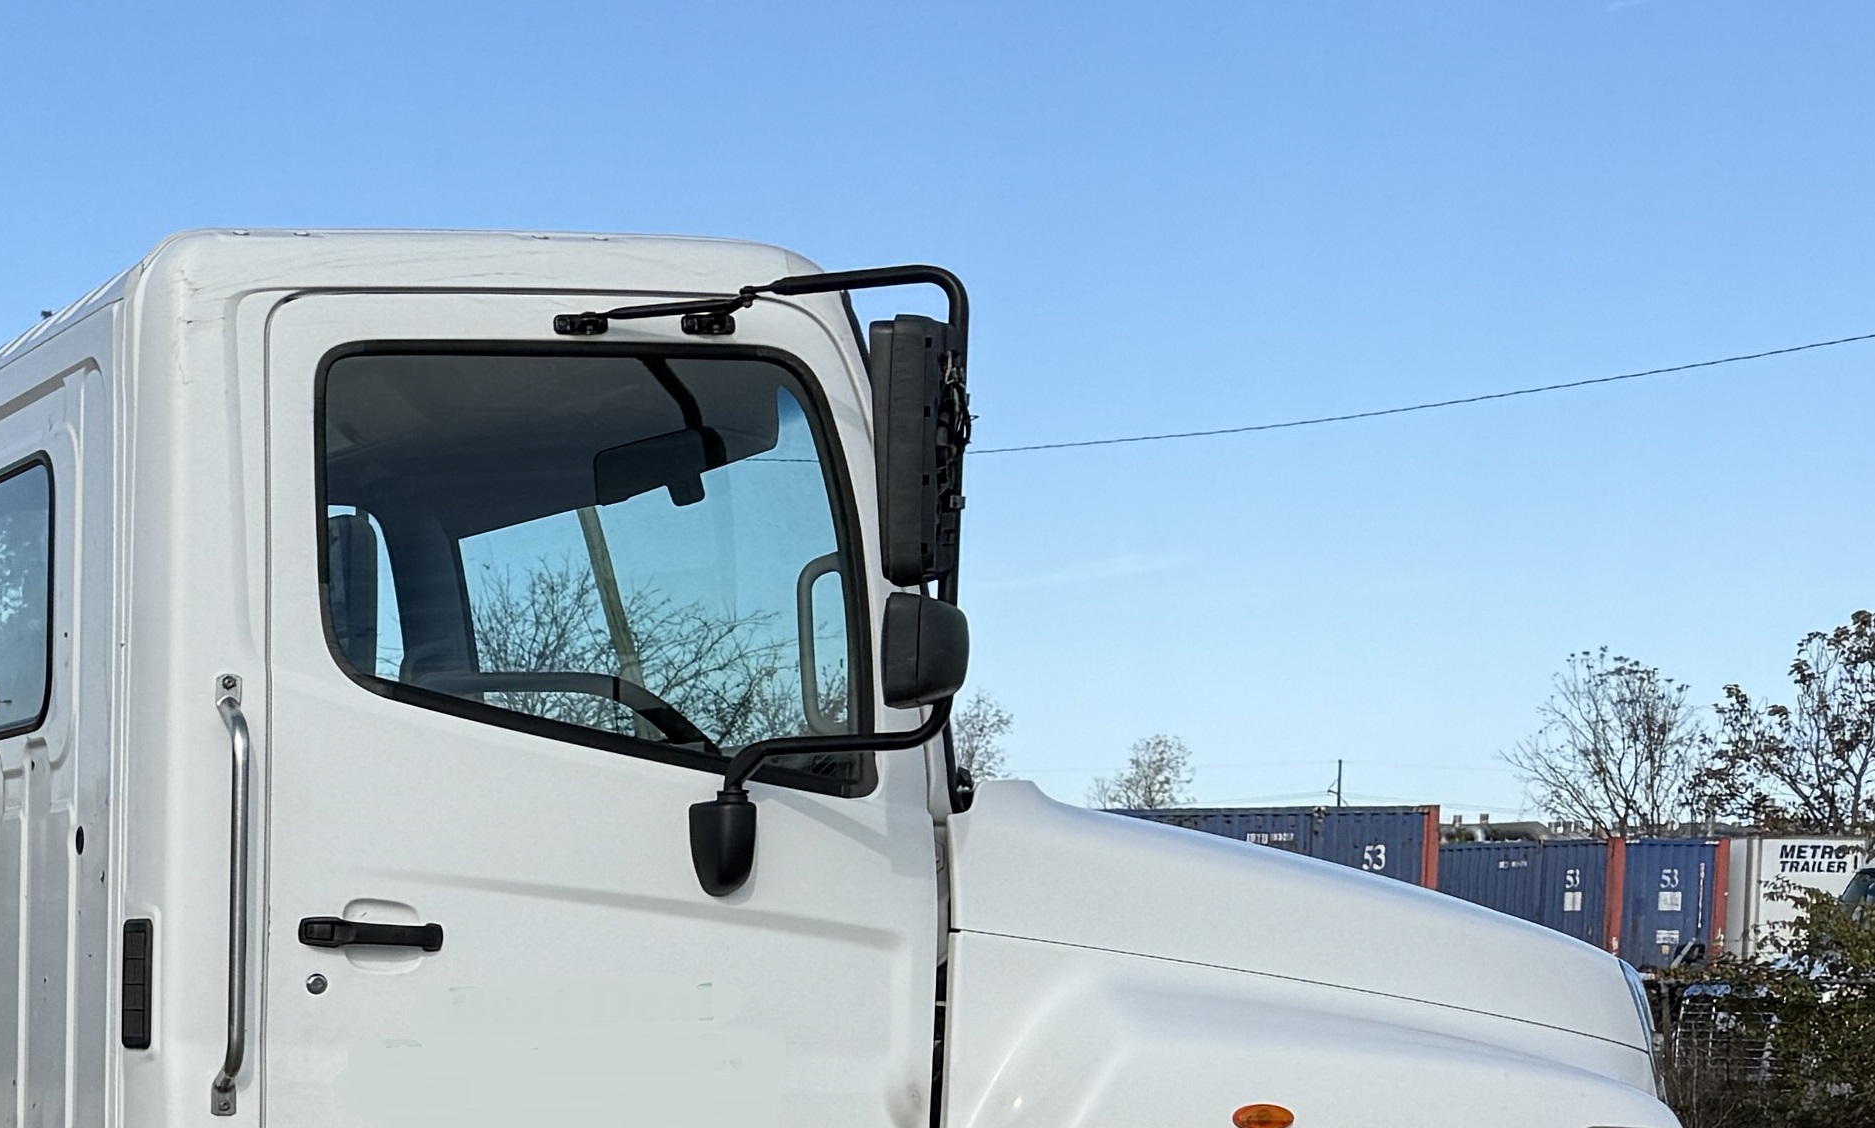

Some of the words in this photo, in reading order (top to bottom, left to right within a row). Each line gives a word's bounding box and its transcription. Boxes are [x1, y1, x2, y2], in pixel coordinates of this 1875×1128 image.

[1362, 844, 1386, 870] 53
[1779, 860, 1848, 873] TRAILER
[1565, 868, 1580, 889] 53
[1660, 869, 1679, 888] 53
